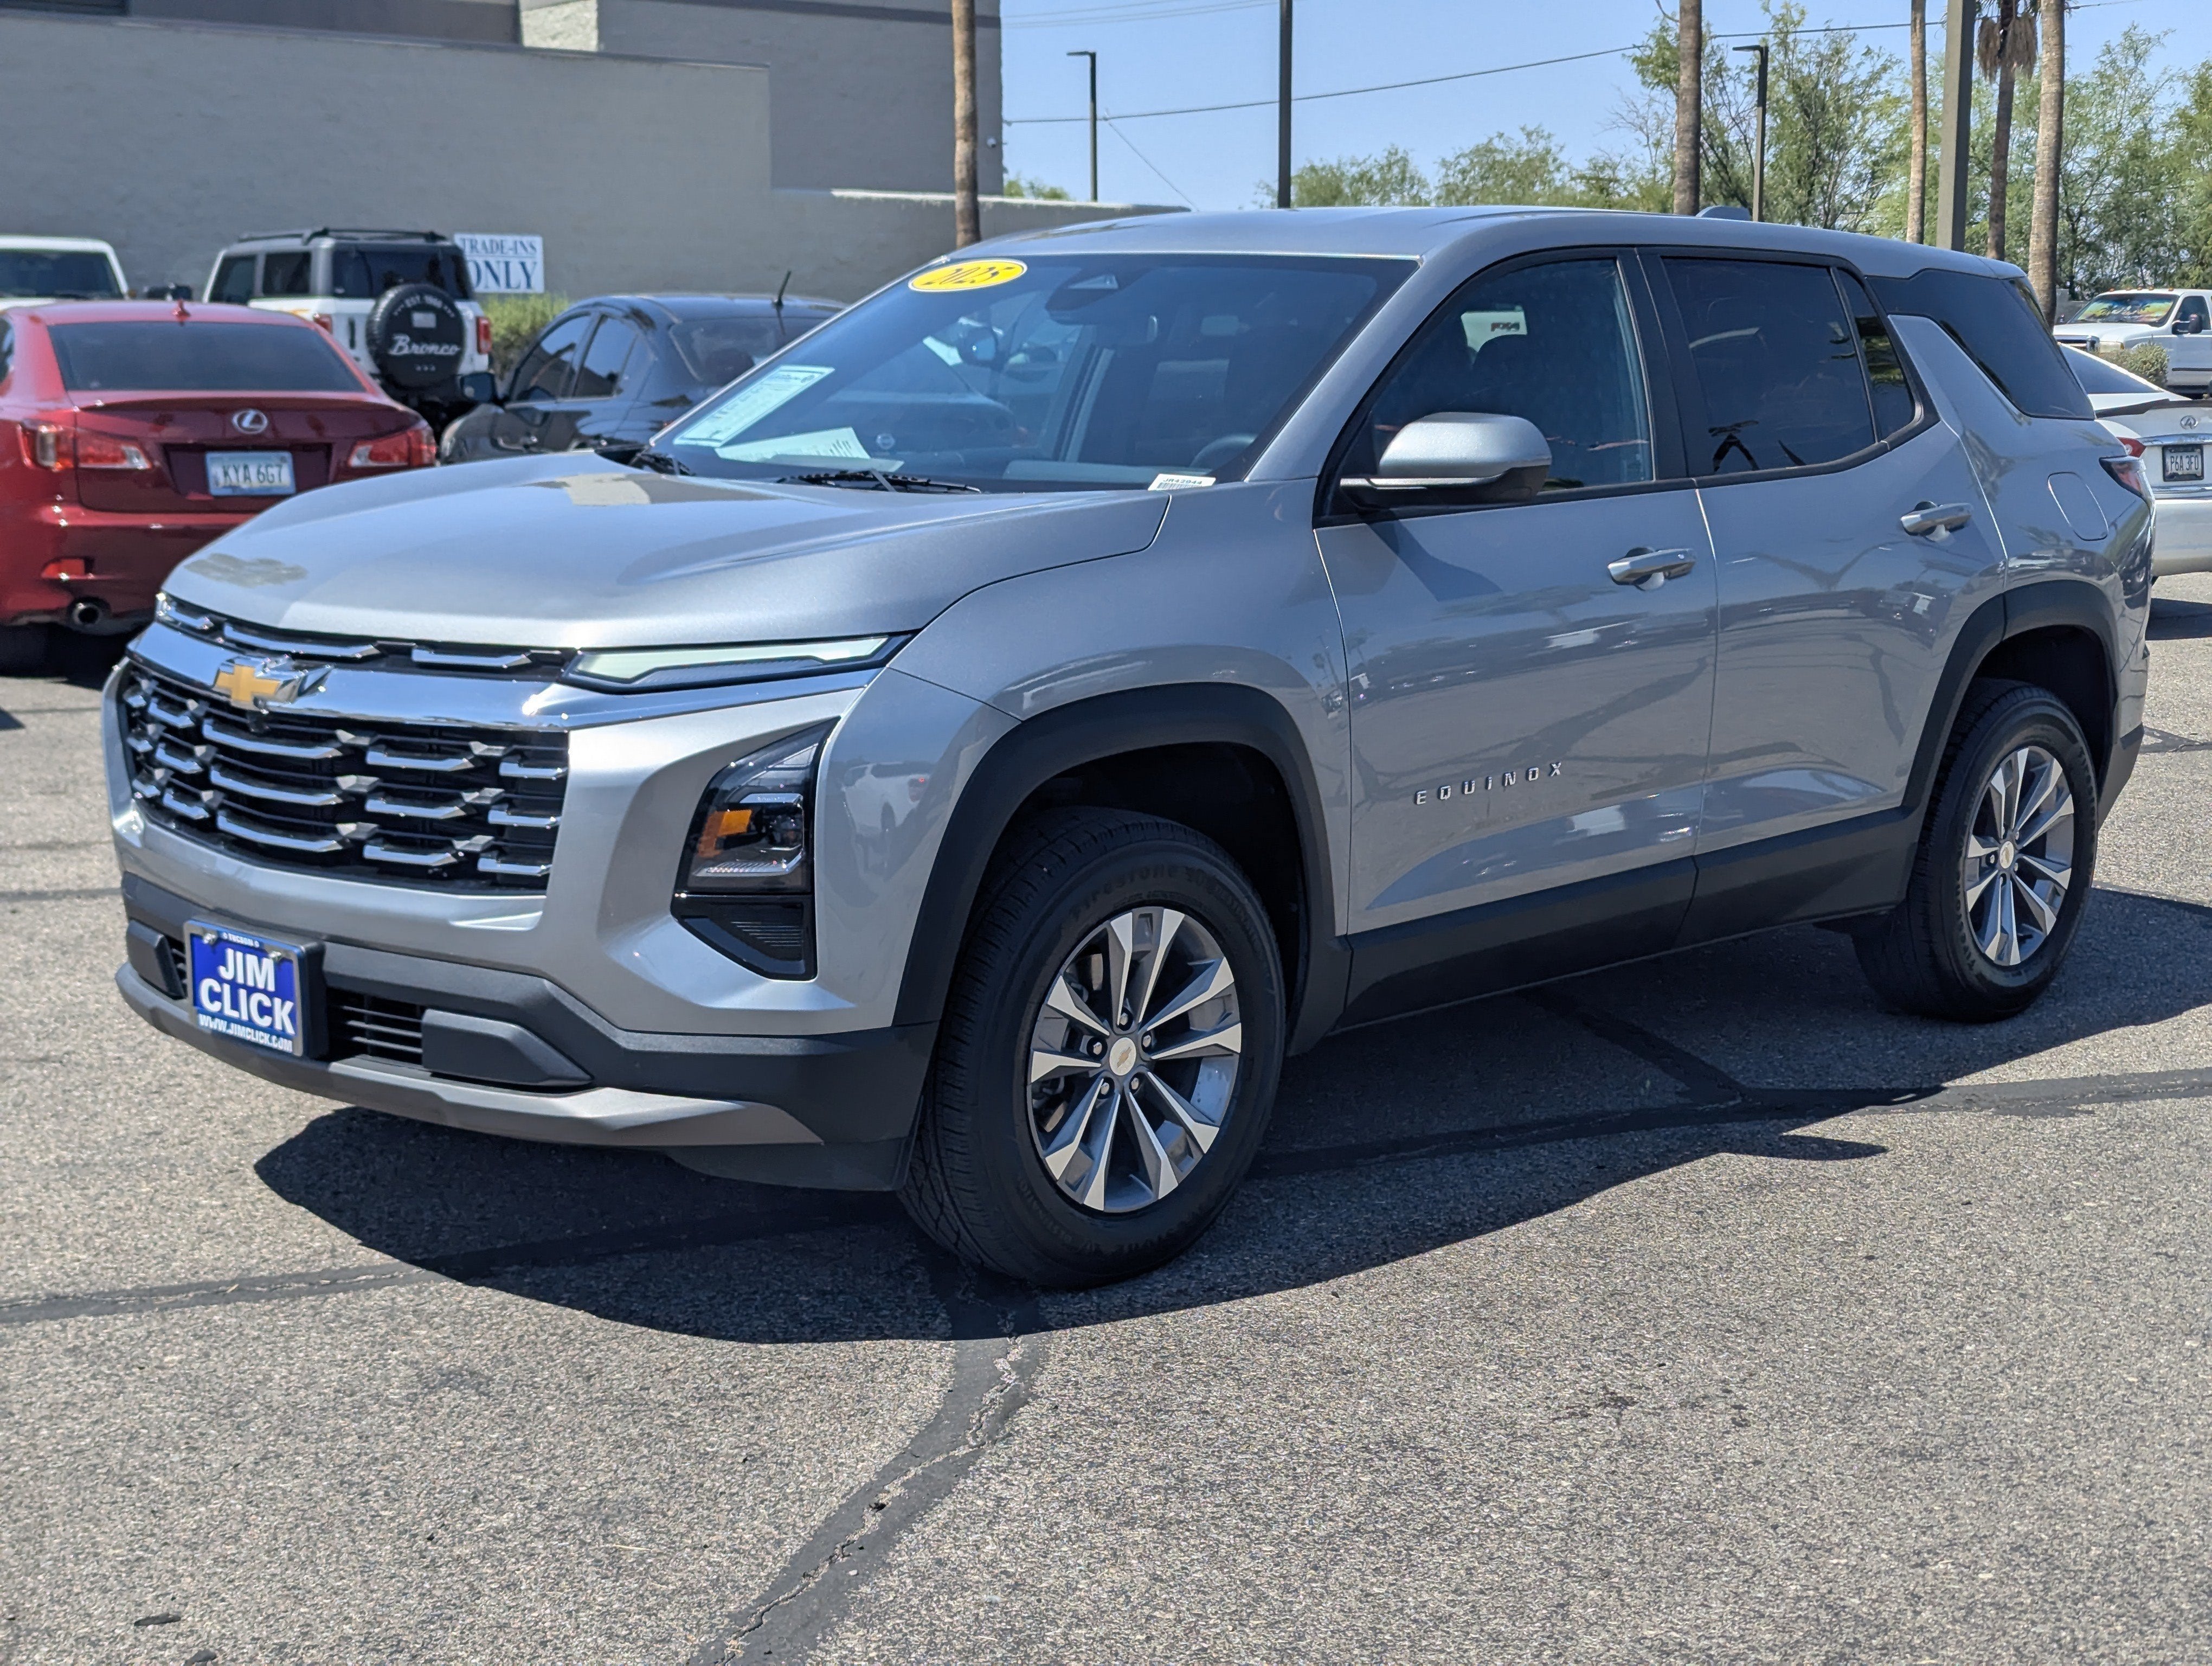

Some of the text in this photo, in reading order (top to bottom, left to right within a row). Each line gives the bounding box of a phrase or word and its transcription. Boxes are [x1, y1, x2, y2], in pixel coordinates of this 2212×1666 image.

[460, 238, 537, 255] TRADE-INS
[921, 266, 1016, 286] 2025
[389, 334, 460, 356] Bronco
[2170, 455, 2184, 471] P6A
[222, 464, 283, 485] KYA 6G7
[1414, 761, 1561, 805] EQUINOX
[218, 948, 275, 992] JIM
[199, 978, 296, 1036] CLICK
